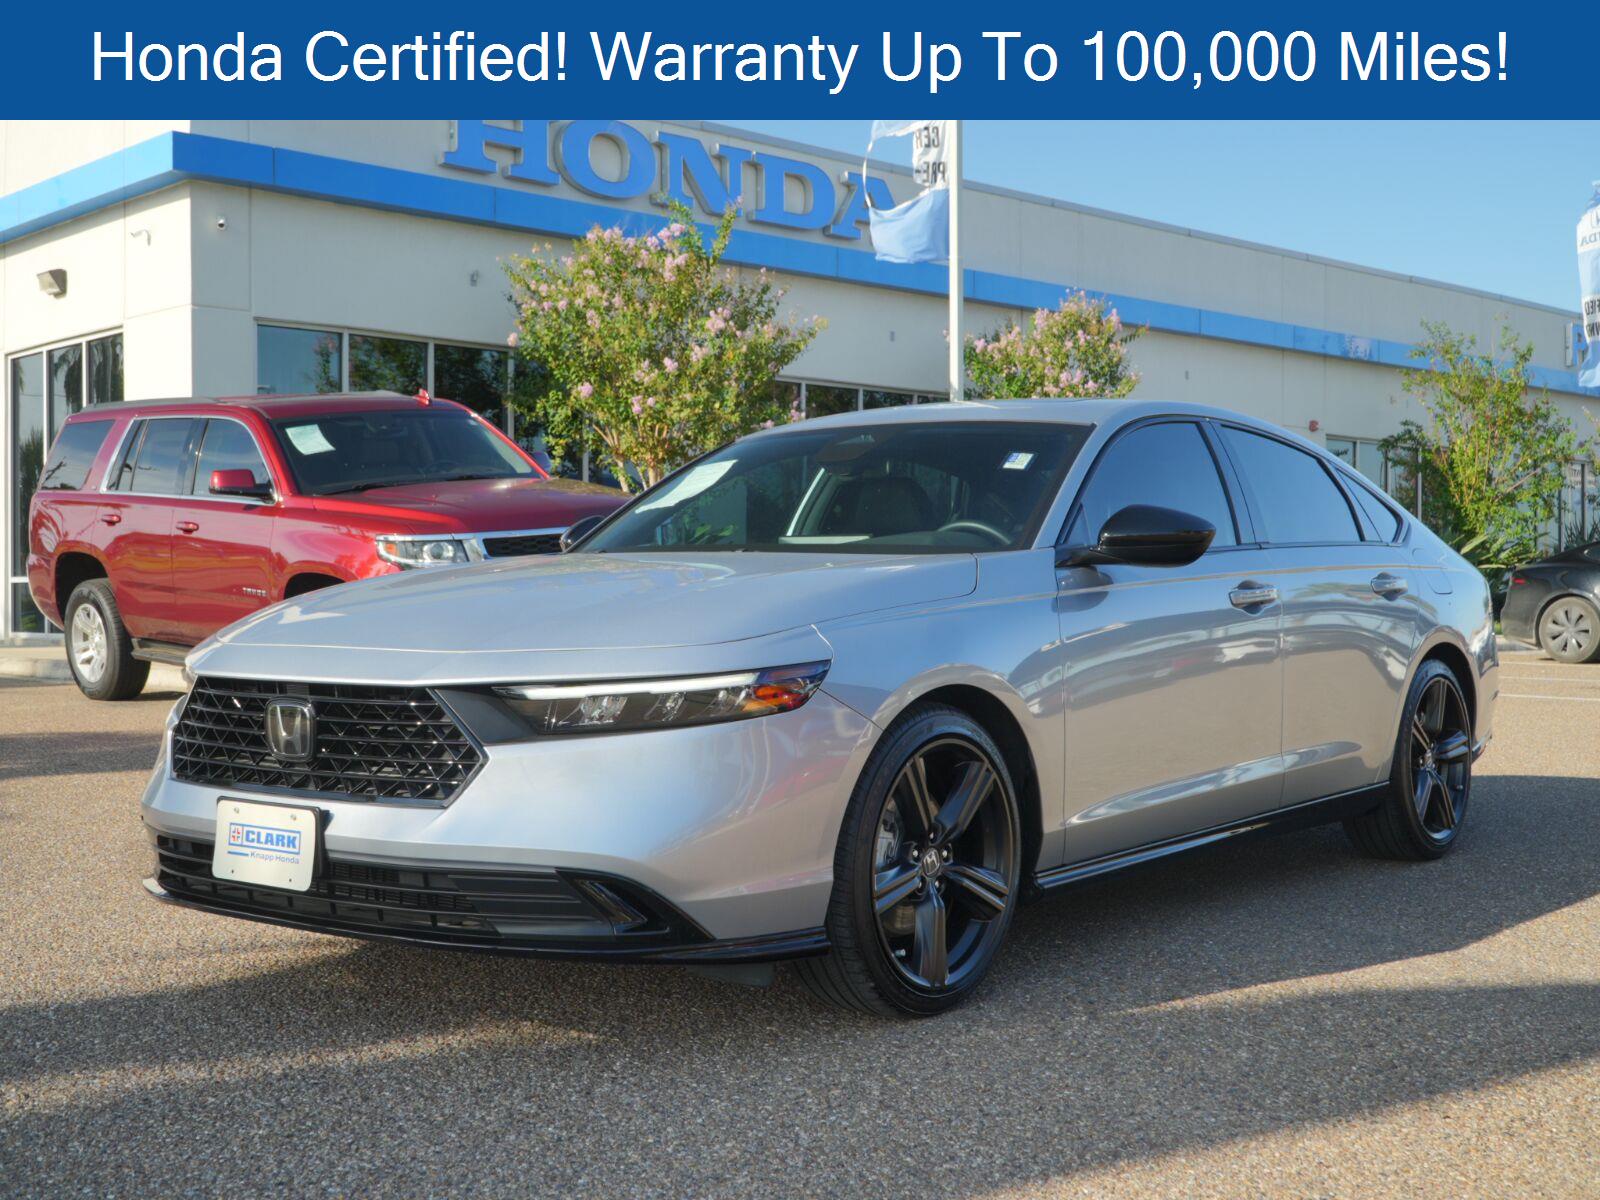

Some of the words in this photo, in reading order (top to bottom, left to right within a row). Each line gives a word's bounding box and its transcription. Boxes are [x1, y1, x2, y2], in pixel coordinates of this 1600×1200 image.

[245, 830, 297, 849] CLARK
[250, 851, 275, 861] Knapp
[275, 853, 300, 864] Honda
